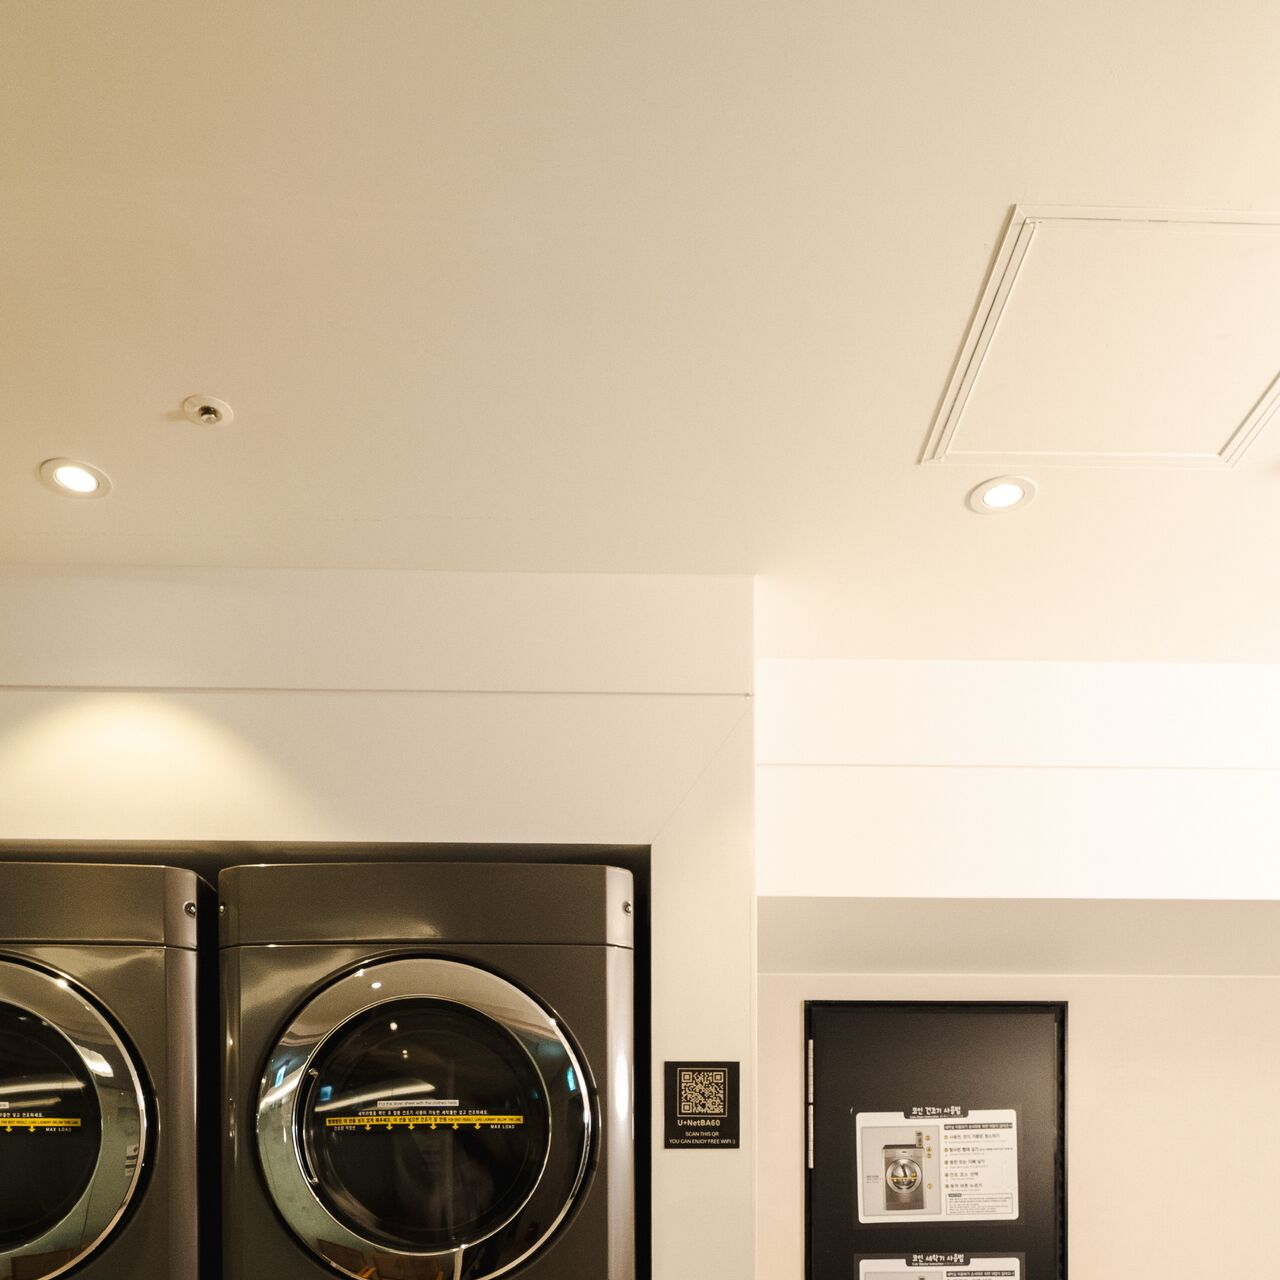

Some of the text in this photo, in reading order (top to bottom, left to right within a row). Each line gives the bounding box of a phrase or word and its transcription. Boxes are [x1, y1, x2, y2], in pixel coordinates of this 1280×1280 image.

[912, 1106, 960, 1115] 코인 건조기 사용법
[912, 1254, 964, 1262] 코인 세탁기 사용법
